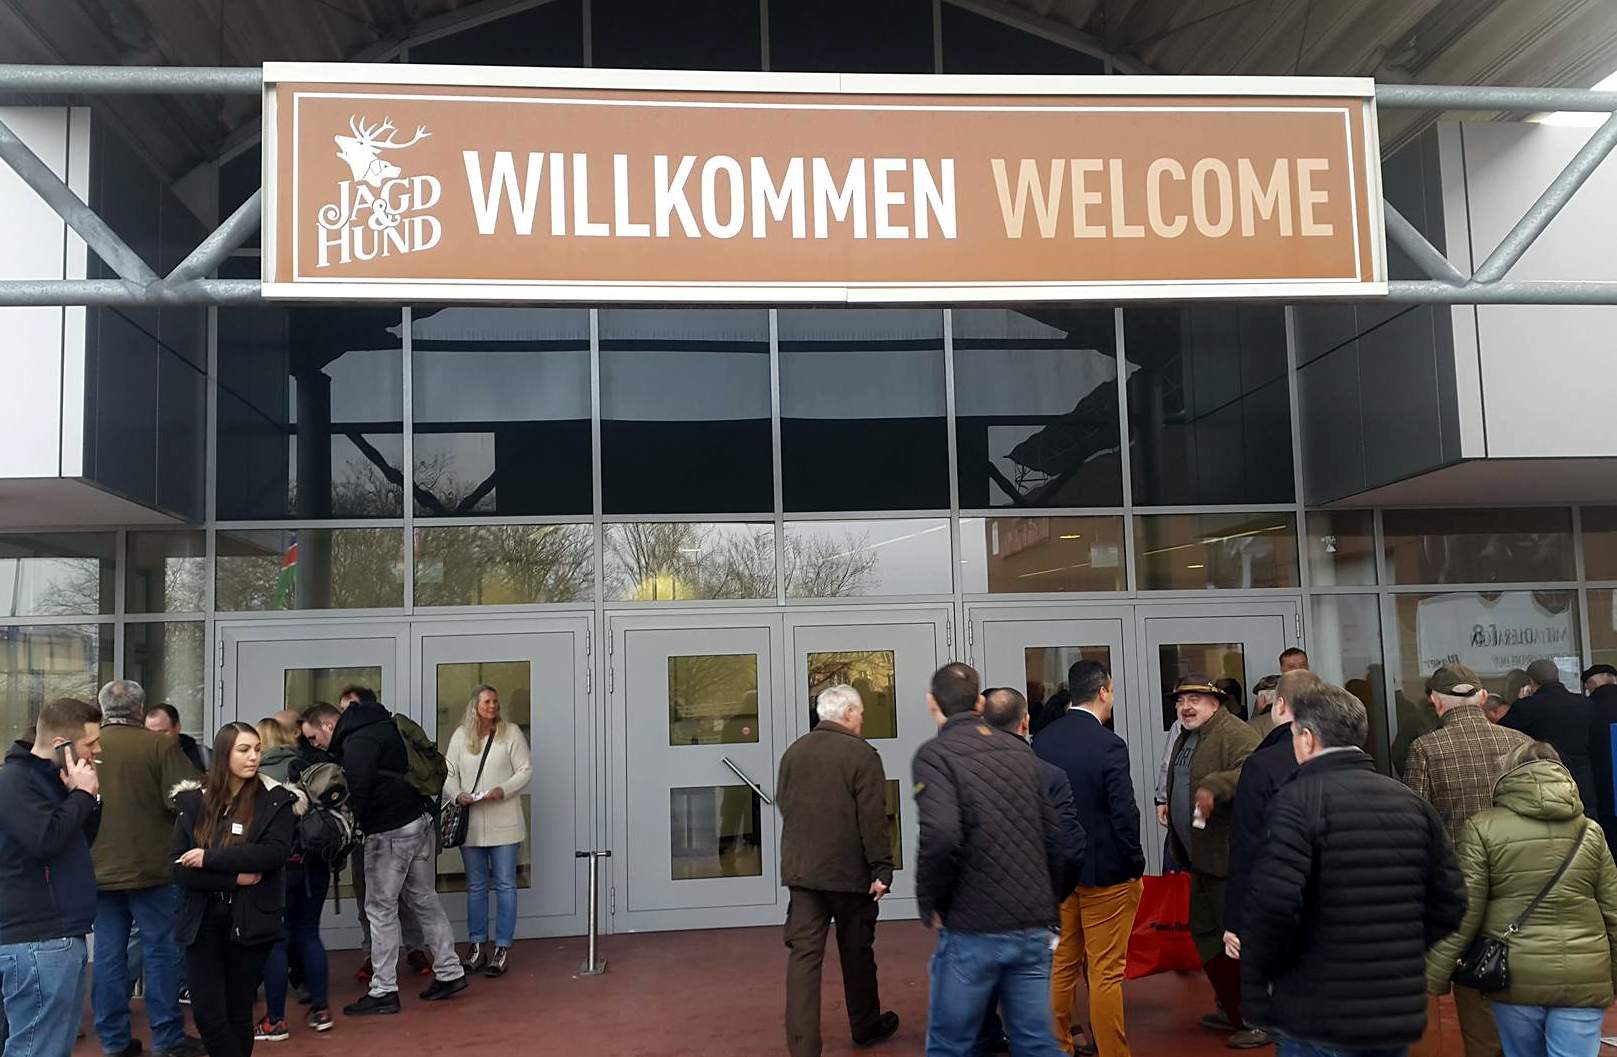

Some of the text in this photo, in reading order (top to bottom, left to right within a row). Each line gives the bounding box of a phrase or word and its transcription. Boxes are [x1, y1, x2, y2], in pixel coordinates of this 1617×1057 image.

[318, 175, 441, 230] JAGD
[368, 199, 400, 231] &
[462, 150, 1334, 239] WILLKOMMEN WELCOME
[316, 215, 442, 268] HUND
